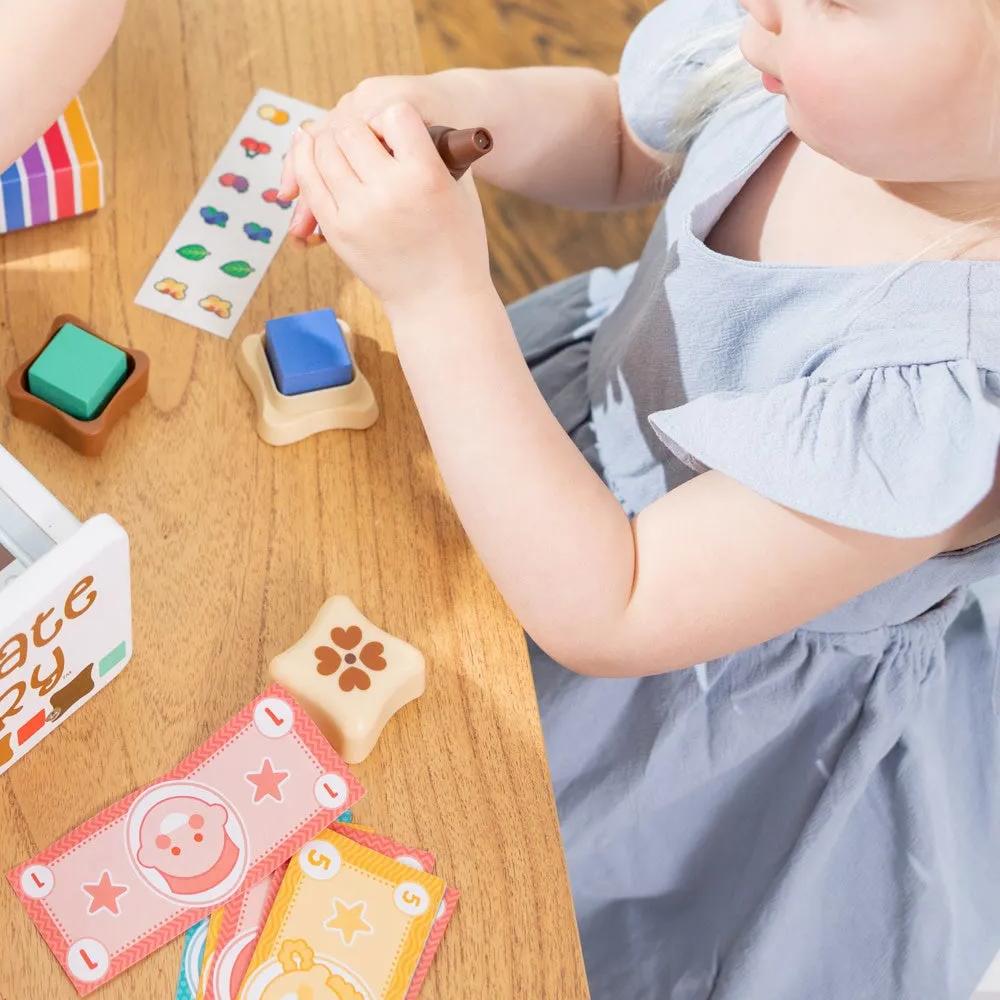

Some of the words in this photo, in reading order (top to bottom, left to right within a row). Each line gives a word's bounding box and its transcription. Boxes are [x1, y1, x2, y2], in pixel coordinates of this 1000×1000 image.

[264, 706, 285, 727] 1
[322, 782, 339, 799] 1
[306, 848, 332, 872] 5
[30, 872, 46, 889] 1
[401, 889, 422, 909] 5
[79, 948, 99, 971] 1
